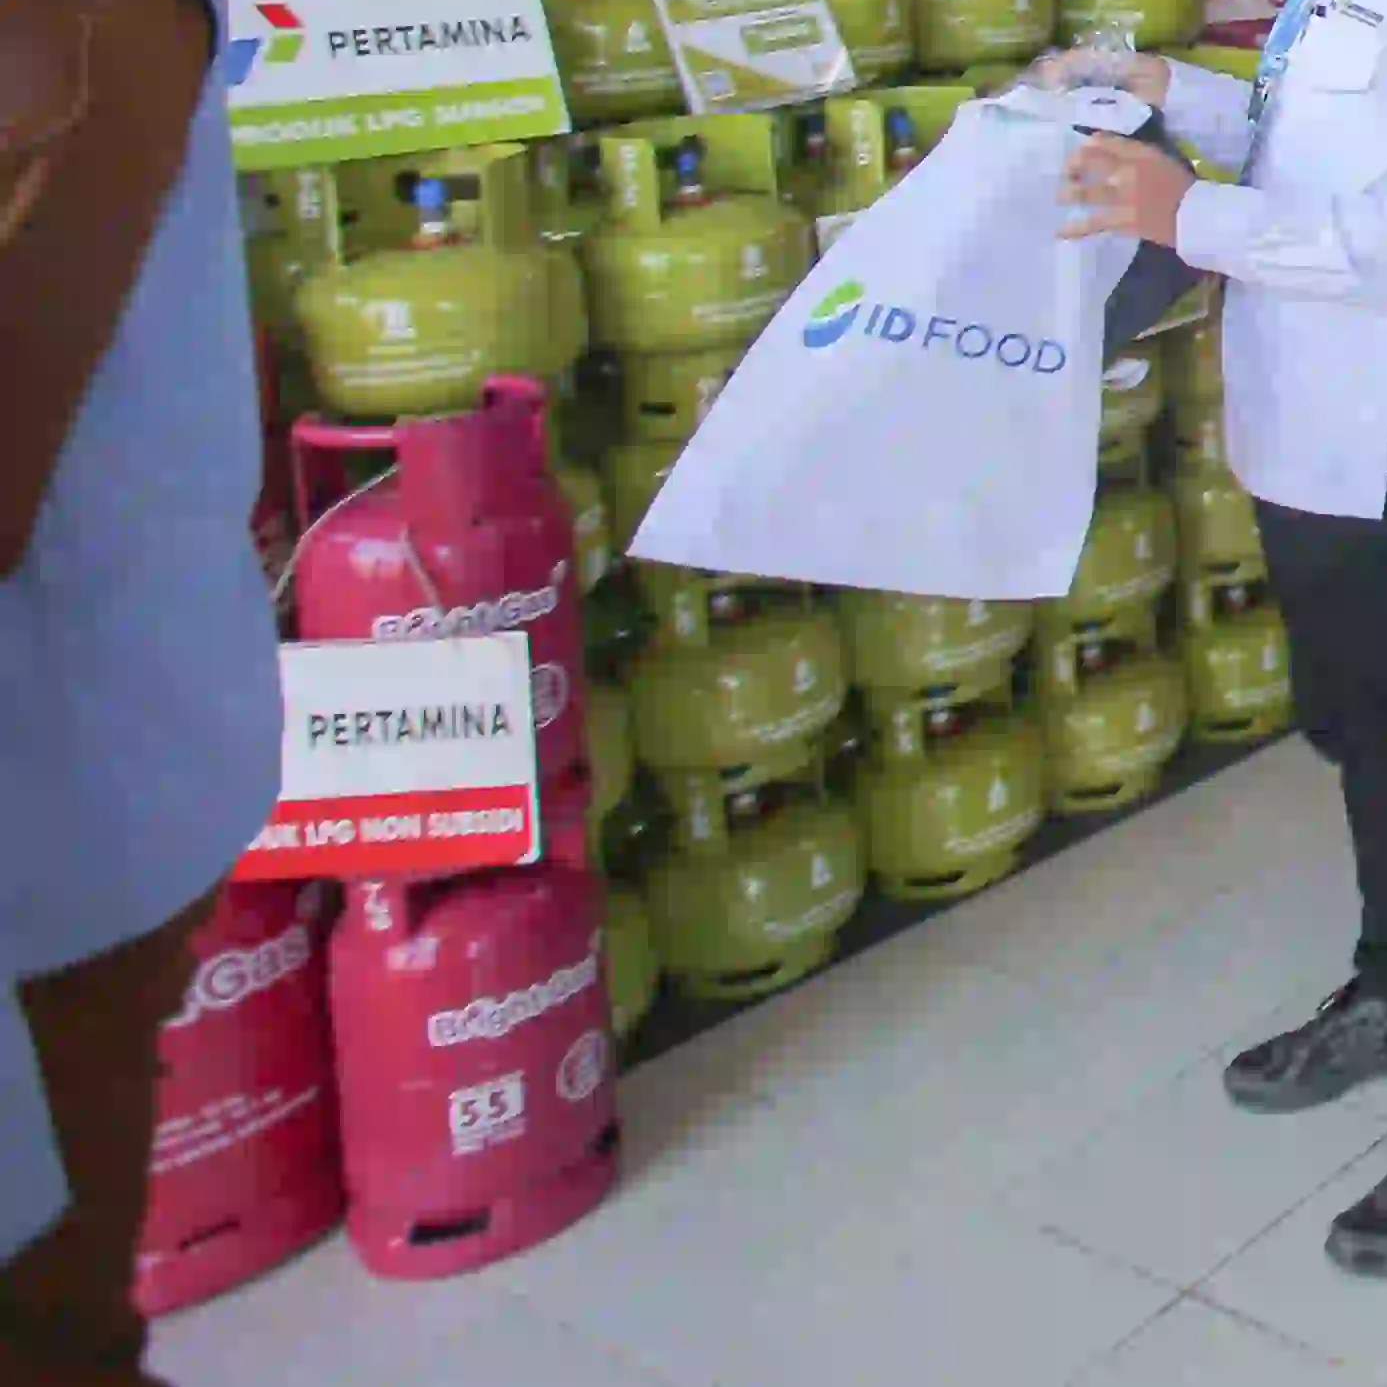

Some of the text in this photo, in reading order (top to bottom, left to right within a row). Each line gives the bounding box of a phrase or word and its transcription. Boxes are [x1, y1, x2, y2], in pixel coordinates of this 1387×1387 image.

[327, 15, 533, 60] PERTAMINA
[367, 106, 425, 133] LPG
[864, 303, 1067, 374] ID FOOD
[307, 704, 513, 749] PERTAMINA
[305, 820, 356, 847] LPG
[359, 813, 422, 843] NON
[428, 808, 523, 837] SUBSIDI
[200, 924, 310, 1006] Gas
